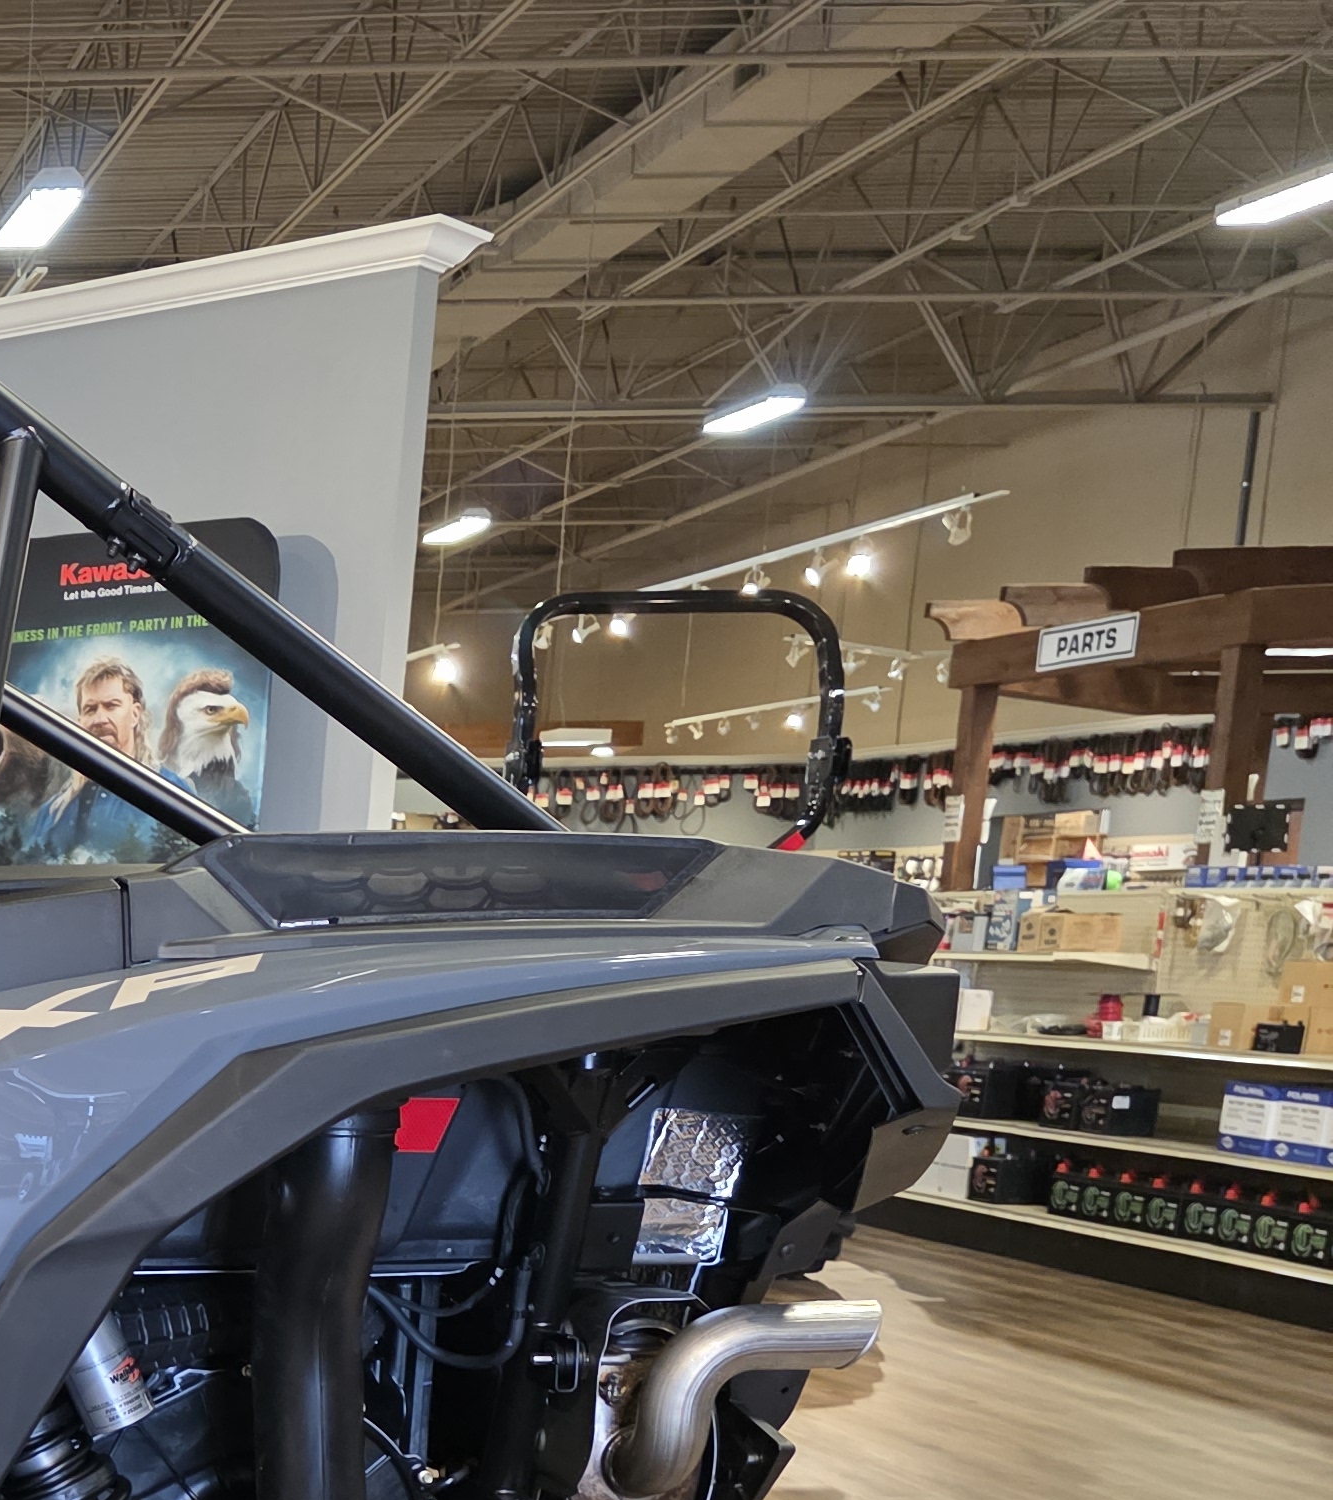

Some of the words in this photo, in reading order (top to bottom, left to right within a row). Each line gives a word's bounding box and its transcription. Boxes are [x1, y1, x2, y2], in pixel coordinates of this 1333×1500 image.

[60, 562, 152, 586] Kawa
[64, 591, 79, 601] Let
[81, 588, 96, 599] the
[97, 586, 123, 598] Good
[124, 584, 152, 596] Times
[47, 626, 59, 639] IN
[62, 624, 83, 638] THE
[86, 621, 126, 636] FRONT.
[129, 617, 168, 632] PARTY
[171, 616, 183, 629] IN
[186, 613, 209, 628] THE
[1056, 628, 1117, 658] PARTS
